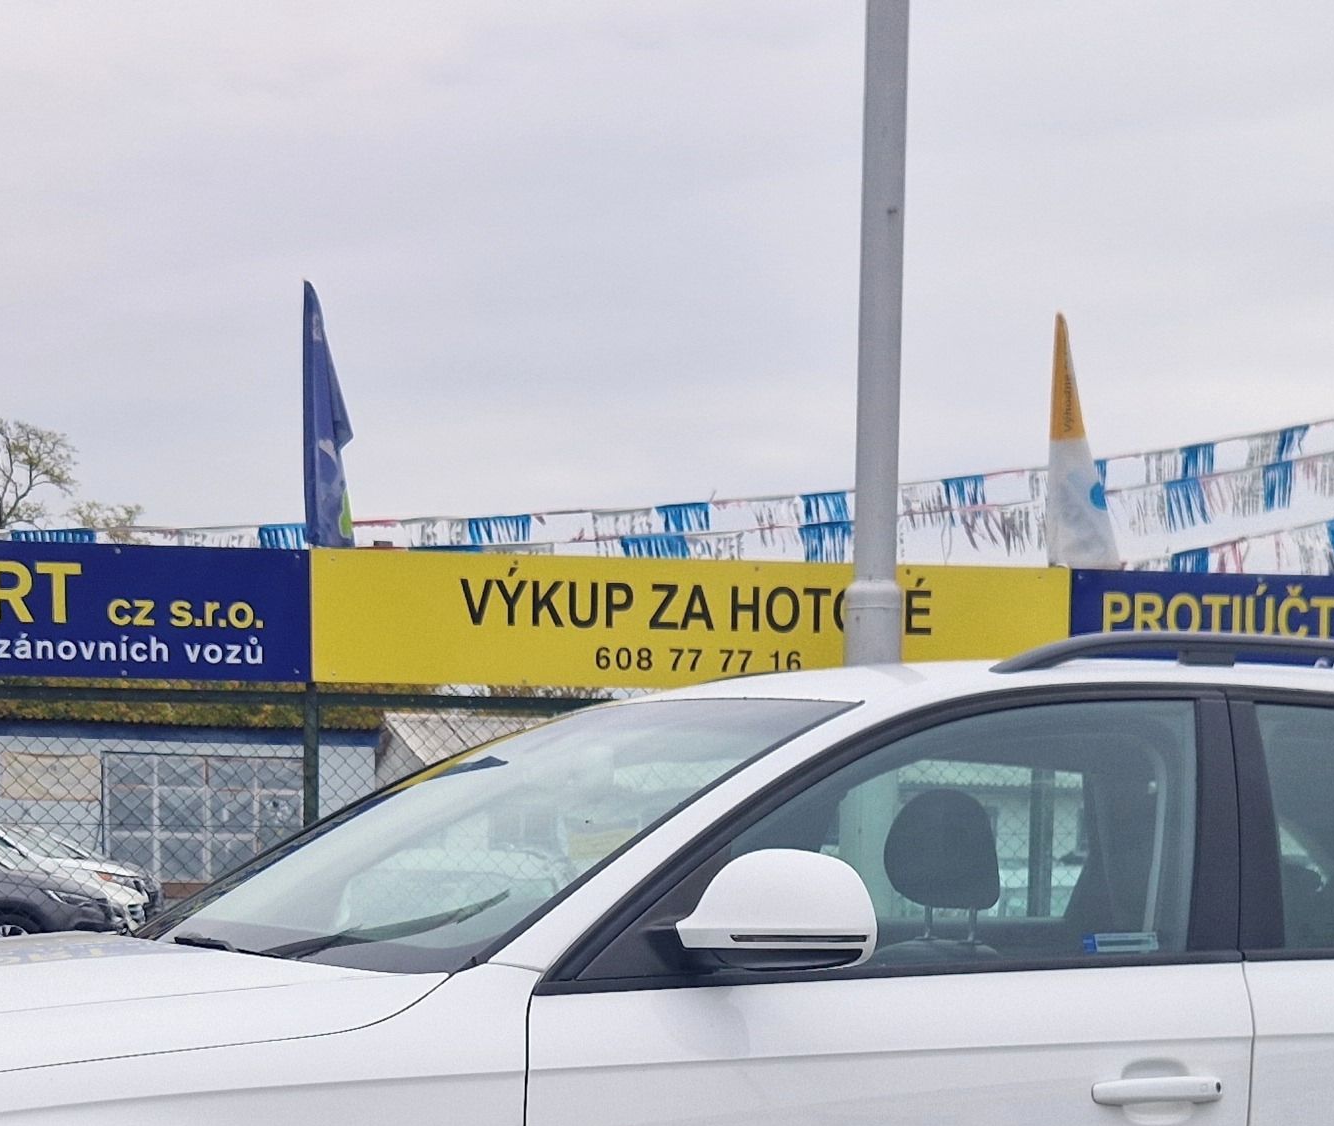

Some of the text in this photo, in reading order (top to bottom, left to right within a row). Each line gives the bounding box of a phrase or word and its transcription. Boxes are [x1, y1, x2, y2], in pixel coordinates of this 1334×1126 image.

[107, 598, 156, 627] cz
[169, 599, 265, 629] s.r.o.
[460, 567, 634, 630] VÝKUP
[648, 582, 716, 632] ZA
[185, 635, 265, 665] vozů
[594, 646, 803, 673] 608 77 77 16
